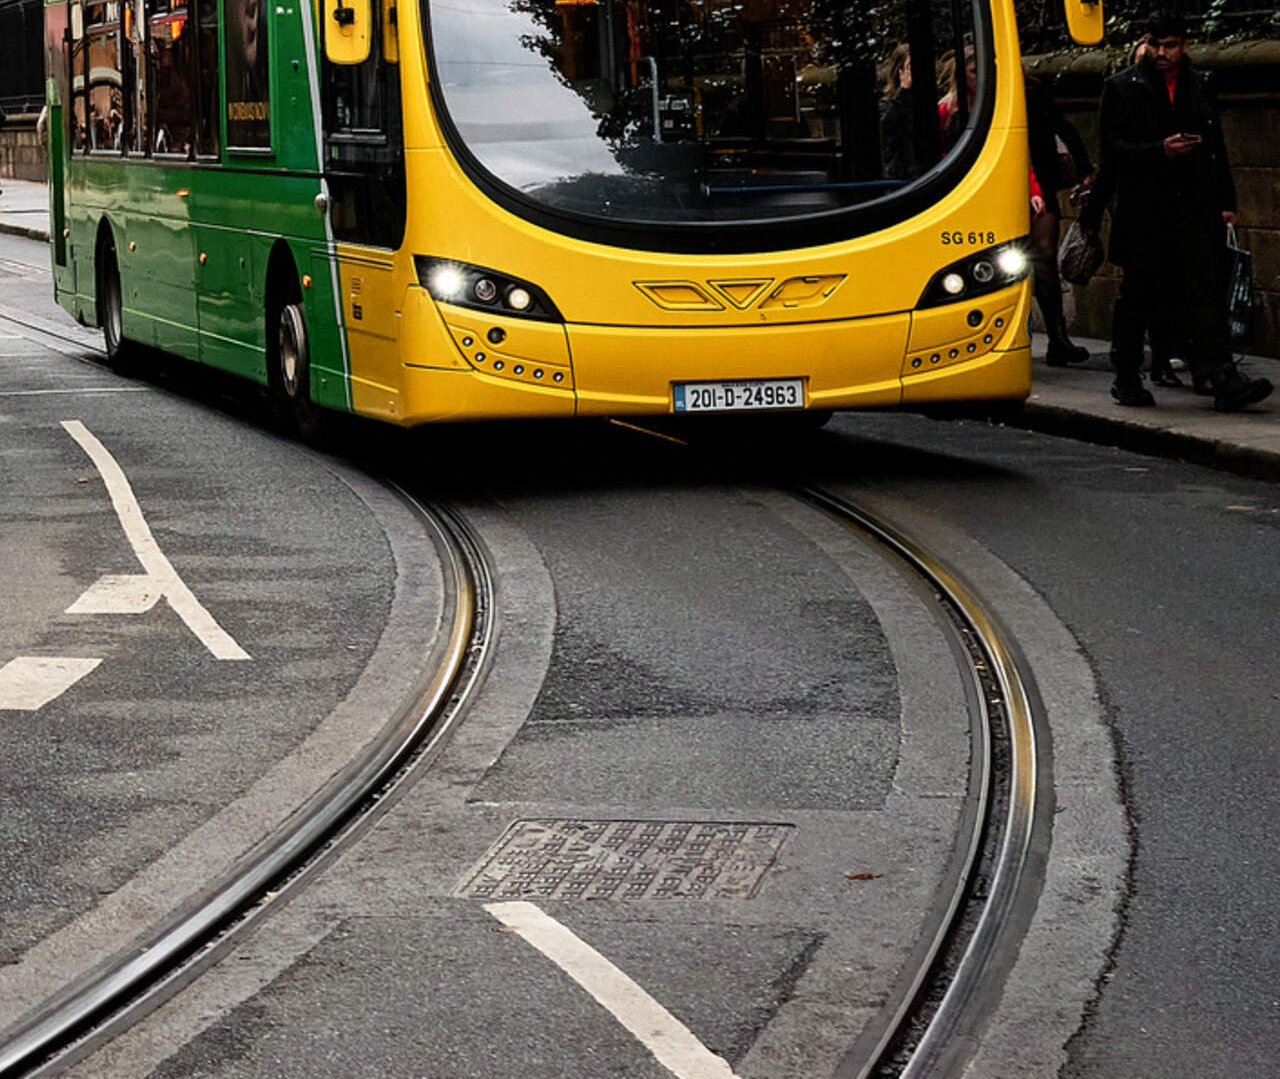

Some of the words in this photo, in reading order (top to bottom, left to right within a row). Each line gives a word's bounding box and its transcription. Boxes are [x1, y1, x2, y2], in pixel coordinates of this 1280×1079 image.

[941, 231, 963, 244] SG
[968, 231, 995, 244] 618
[690, 385, 797, 408] 201-D-24963
